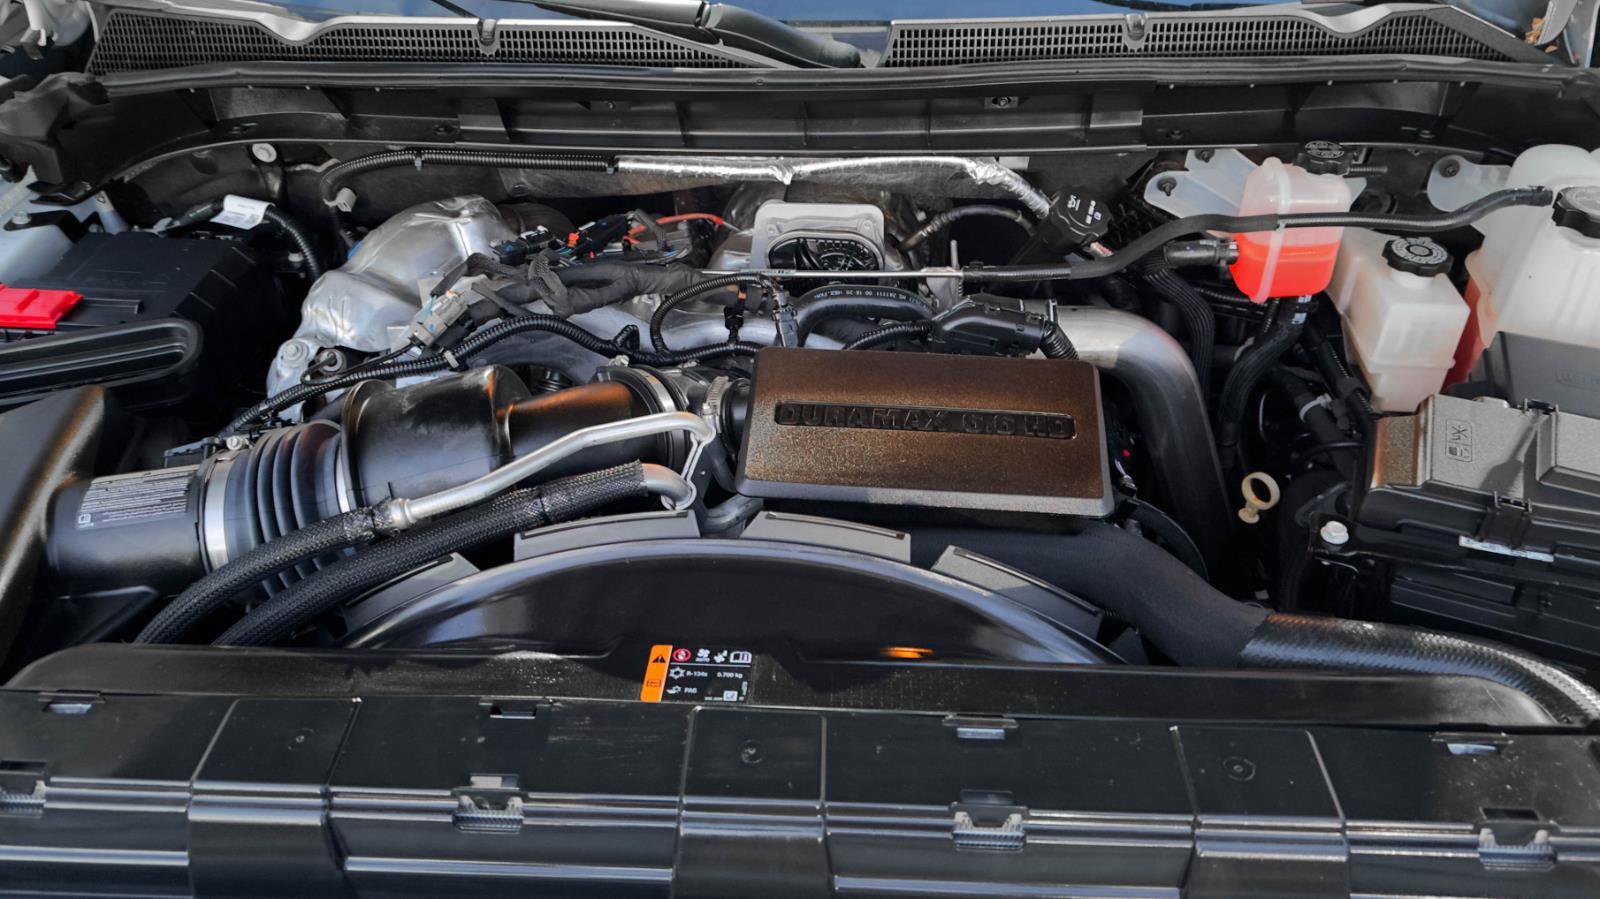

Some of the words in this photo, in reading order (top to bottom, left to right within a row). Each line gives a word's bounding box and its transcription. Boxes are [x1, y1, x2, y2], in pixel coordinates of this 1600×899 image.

[780, 404, 949, 431] DURAMAX
[962, 412, 1016, 436] 6.6
[1024, 415, 1074, 438] HD
